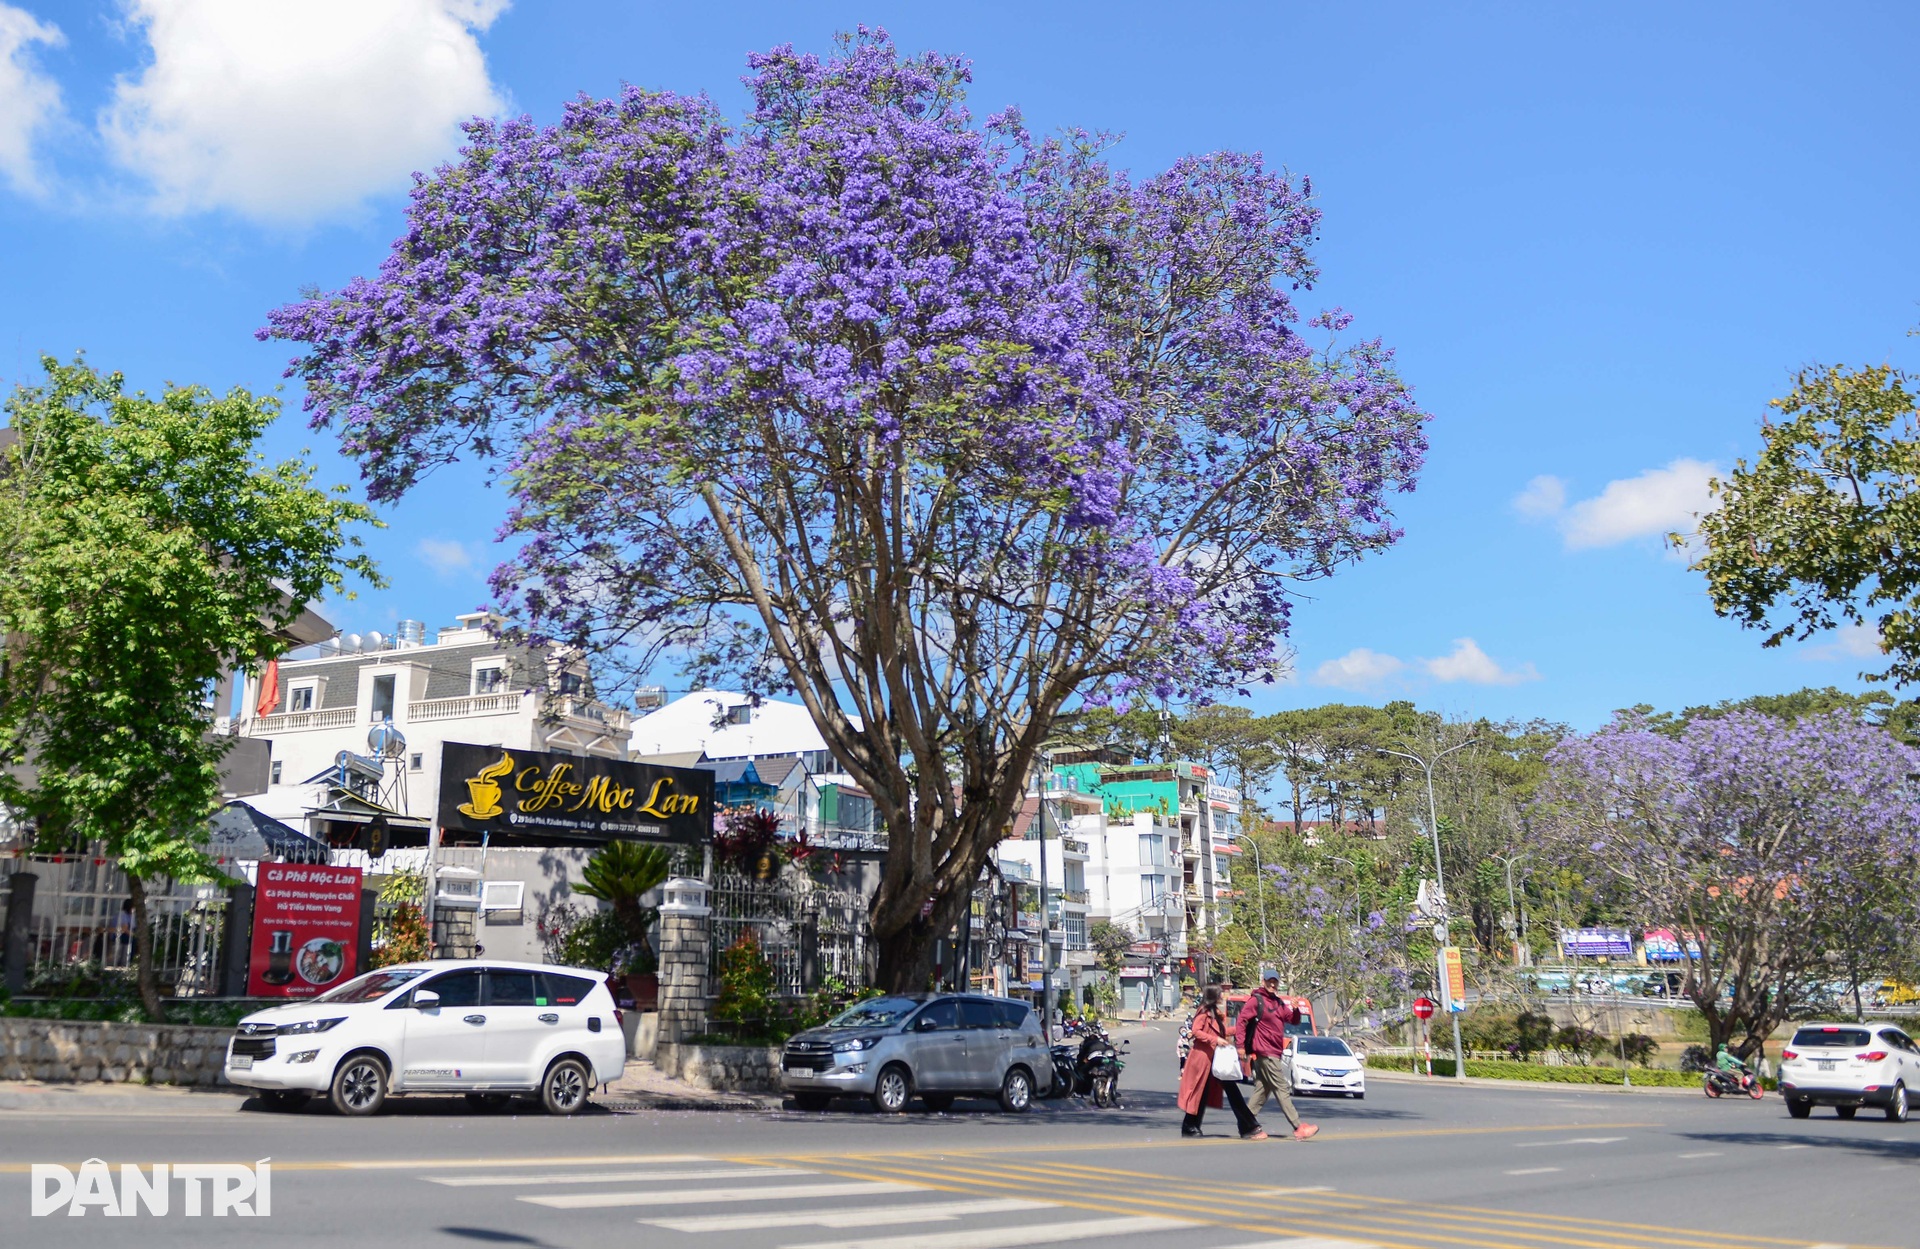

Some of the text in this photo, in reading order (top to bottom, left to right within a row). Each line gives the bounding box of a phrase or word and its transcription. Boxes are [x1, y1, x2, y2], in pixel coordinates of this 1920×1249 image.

[514, 762, 699, 819] Coffee Mộc Lan
[268, 870, 356, 886] Cà Phê Mộc Lan
[292, 891, 308, 899] Phin
[324, 905, 342, 913] Vang
